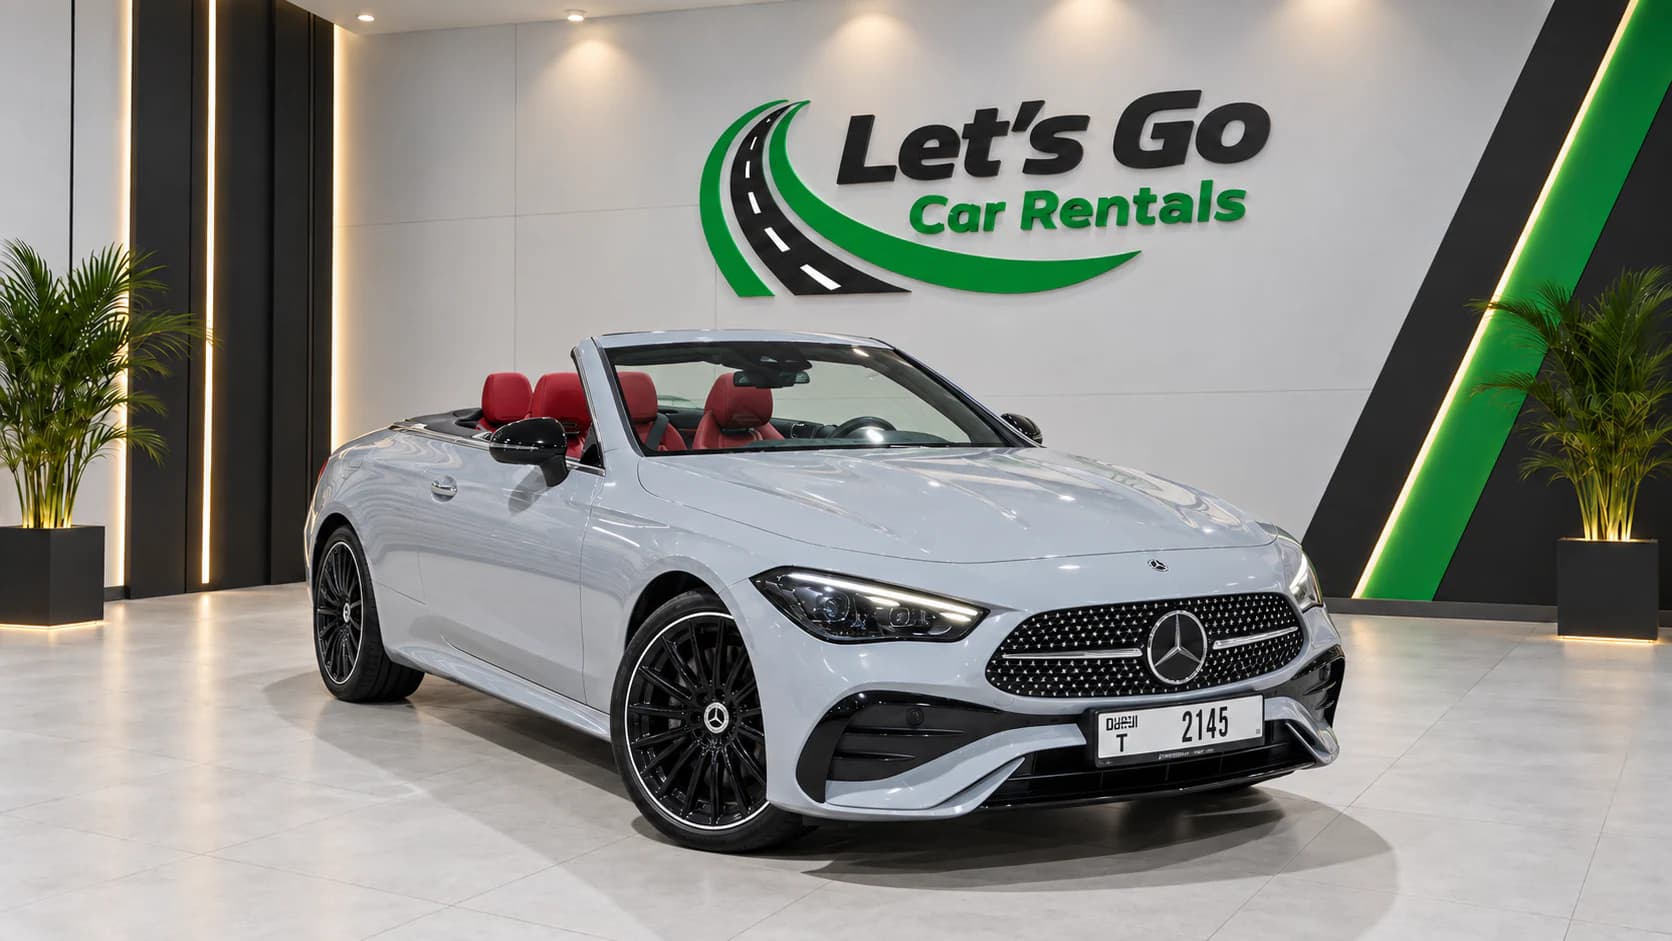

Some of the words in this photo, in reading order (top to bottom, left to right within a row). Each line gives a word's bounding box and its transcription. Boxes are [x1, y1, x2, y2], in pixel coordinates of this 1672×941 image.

[837, 100, 1091, 185] Let's
[1112, 90, 1271, 170] Go
[909, 194, 1006, 235] Car
[1020, 179, 1246, 231] Rentals
[1116, 733, 1128, 752] T
[1181, 706, 1229, 743] 2145
